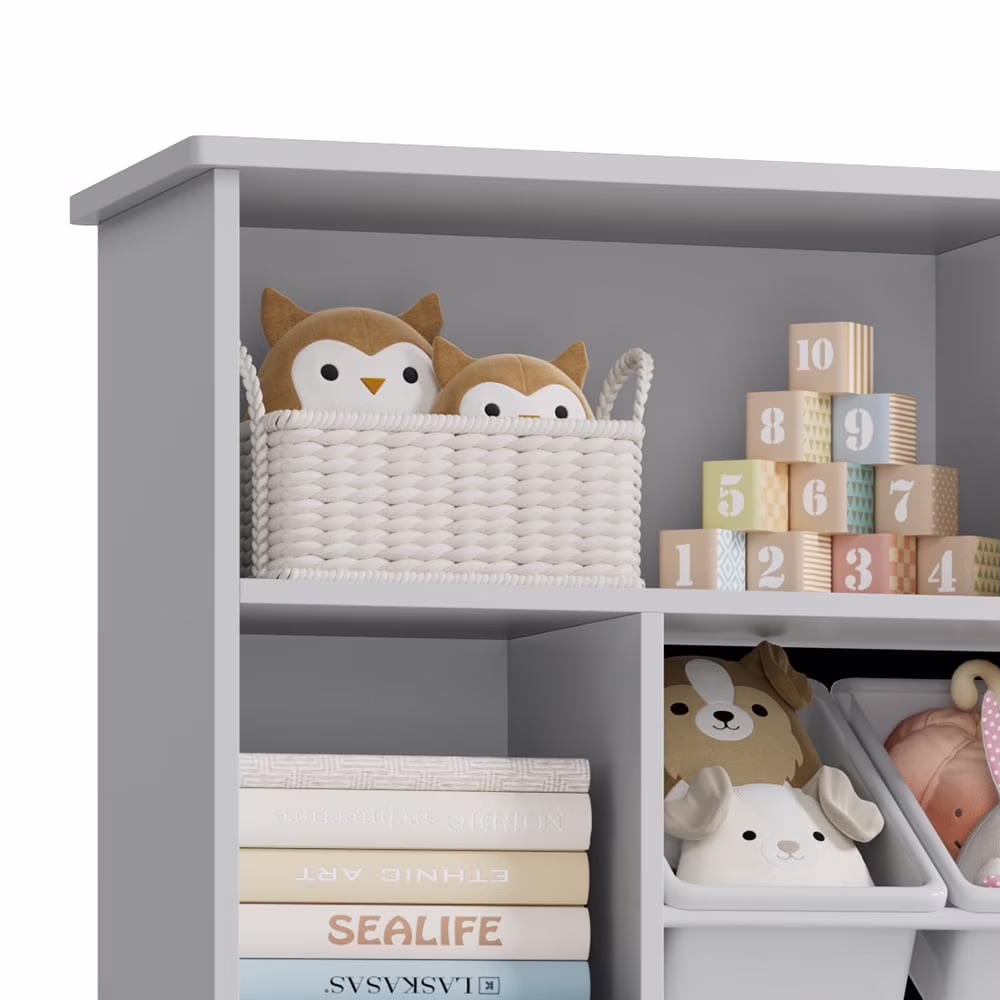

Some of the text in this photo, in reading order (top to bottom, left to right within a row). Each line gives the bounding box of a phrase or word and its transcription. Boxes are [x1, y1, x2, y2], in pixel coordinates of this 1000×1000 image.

[795, 337, 834, 371] 10
[760, 407, 786, 445] 8
[844, 408, 874, 451] 9
[718, 474, 745, 517] 5
[803, 479, 828, 516] 6
[889, 479, 914, 522] 7
[675, 543, 694, 587] 1
[758, 545, 785, 588] 2
[845, 547, 872, 591] 3
[928, 550, 957, 592] 4
[447, 811, 566, 833] NORDIC
[295, 866, 509, 883] ETHNIC ART
[327, 914, 503, 946] SEALIFE
